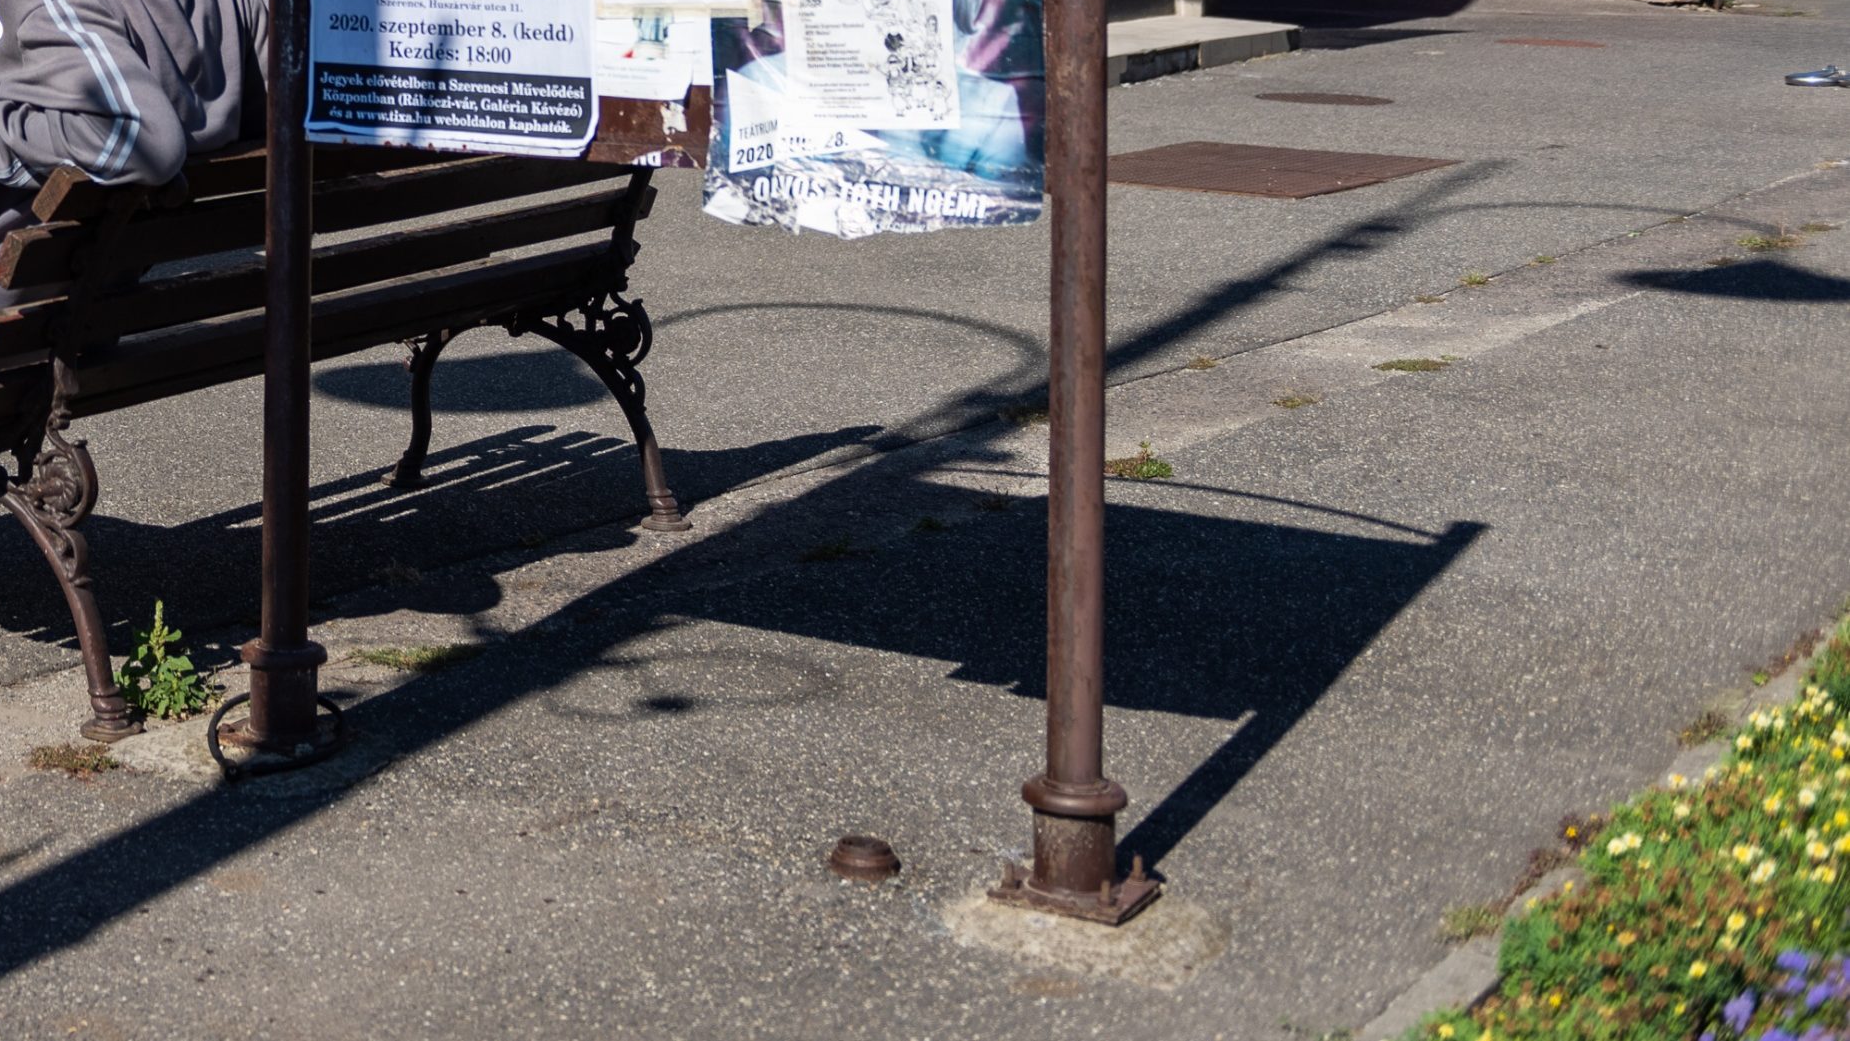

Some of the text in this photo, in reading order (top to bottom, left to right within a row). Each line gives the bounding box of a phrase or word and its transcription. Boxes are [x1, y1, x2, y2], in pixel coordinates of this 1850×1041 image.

[484, 2, 507, 12] utca
[329, 14, 575, 44] 2020. szeptember 8. (kedd)
[389, 41, 511, 65] Kezdés: 18:00
[320, 71, 364, 87] Jegyek
[366, 75, 436, 91] elővételben
[438, 82, 447, 91] a
[449, 79, 508, 95] Szerencsi
[322, 88, 583, 119] Központban (Rákóczi-vár, Galéria Kávézó)
[329, 106, 573, 134] és a www.tixa.hu weboldalon kaphatók.
[738, 119, 778, 140] TEÁTRUM
[736, 142, 774, 166] 2020
